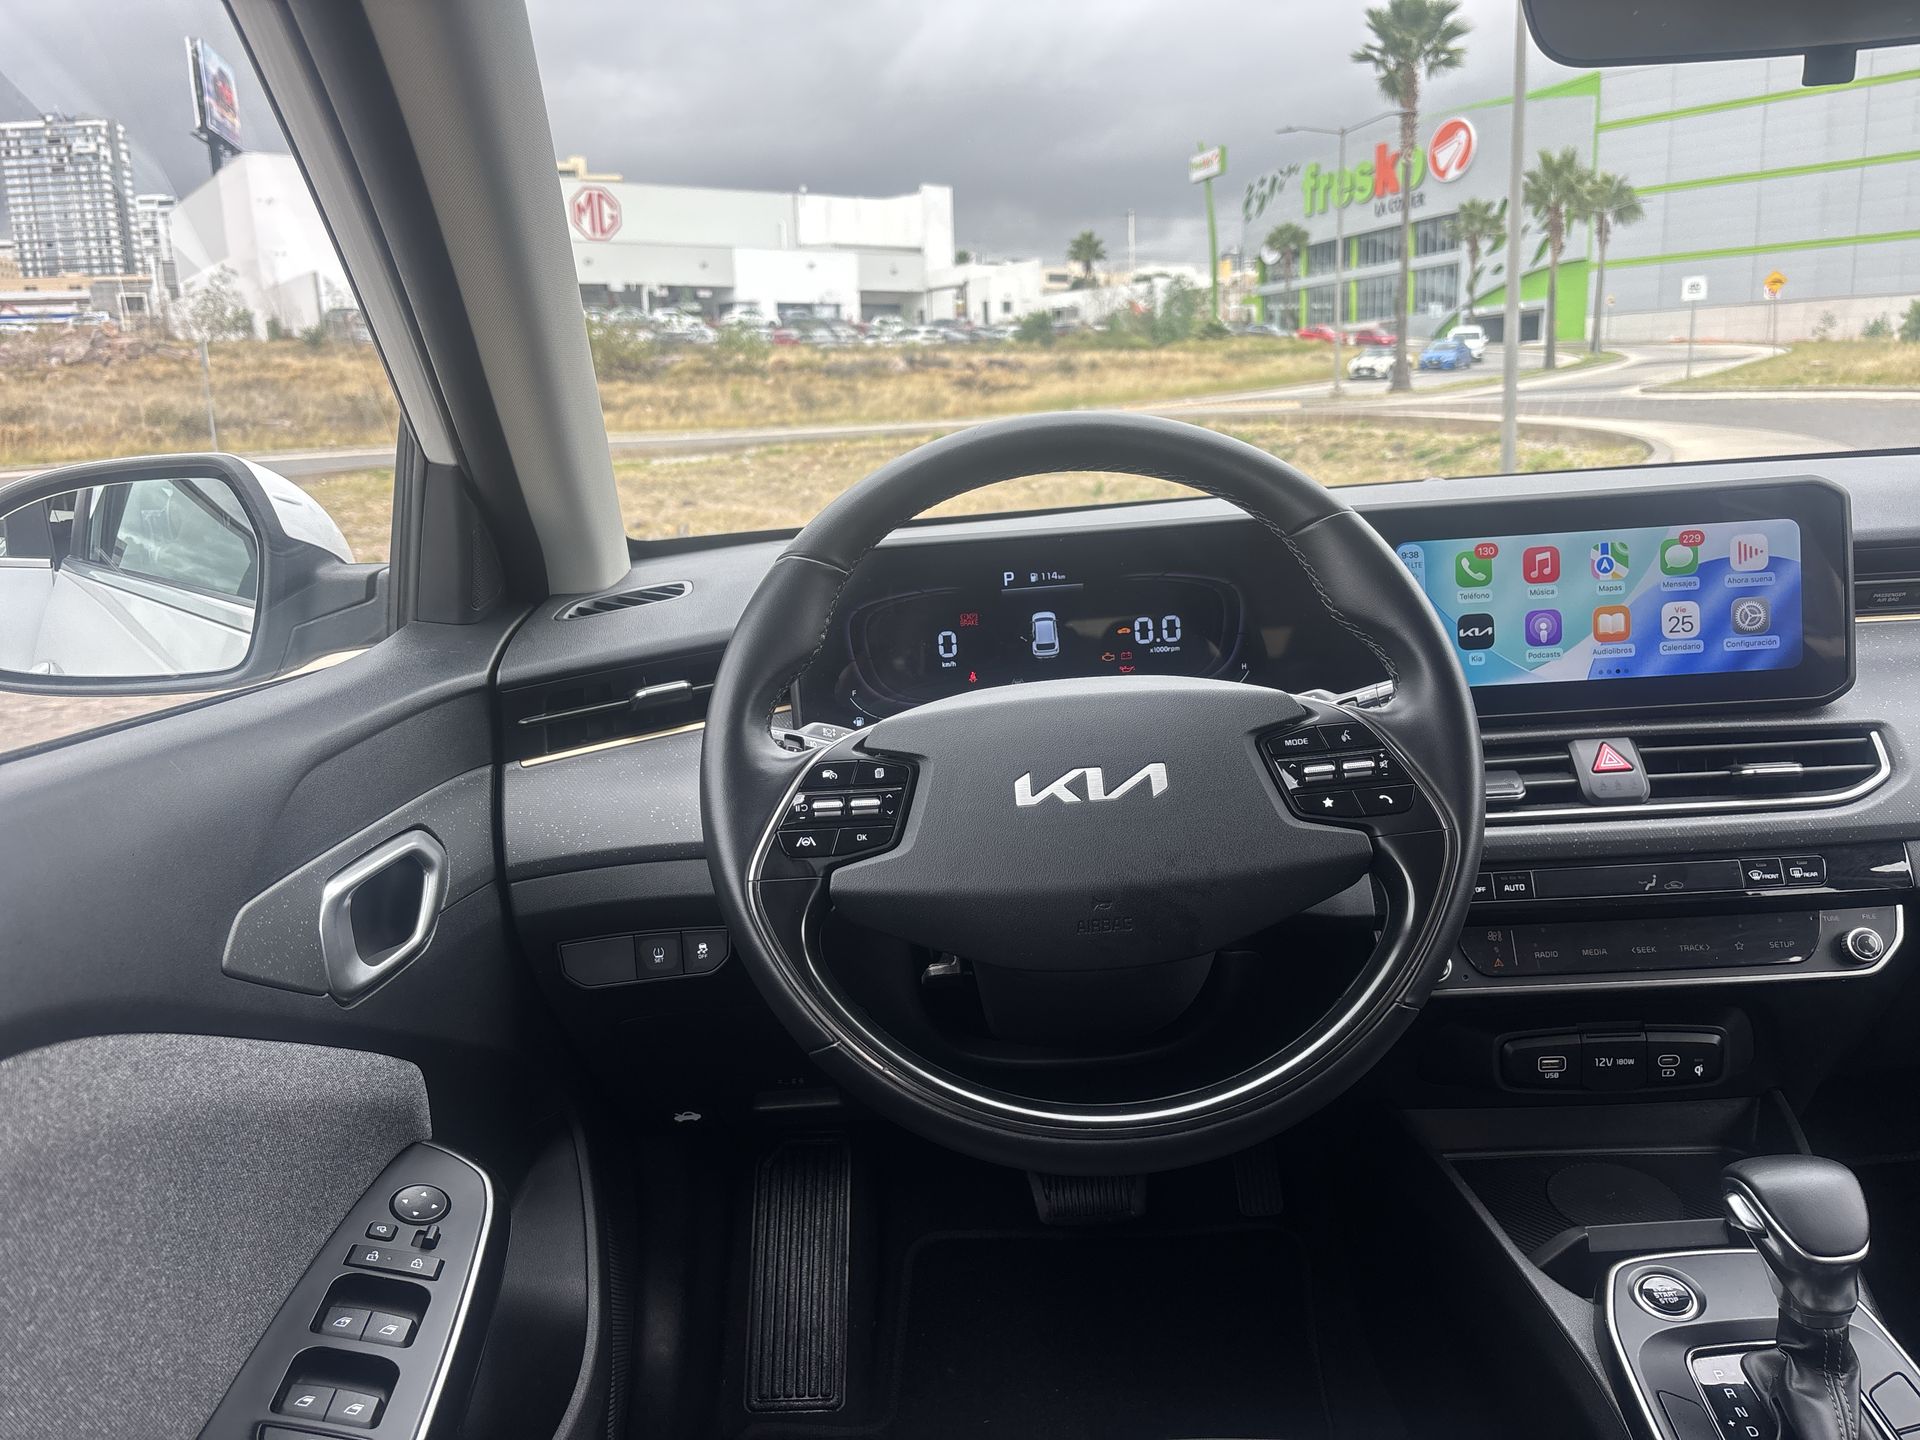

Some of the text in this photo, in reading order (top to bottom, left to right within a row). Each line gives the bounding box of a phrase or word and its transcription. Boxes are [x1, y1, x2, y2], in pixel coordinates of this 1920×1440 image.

[572, 190, 619, 236] MG
[1682, 534, 1701, 543] 229
[1401, 551, 1419, 559] 9:38
[1478, 546, 1495, 556] 130
[1411, 561, 1423, 569] LTE
[1003, 571, 1015, 587] P
[1727, 577, 1749, 585] Ahora
[1598, 584, 1623, 593] Mapas
[1662, 580, 1697, 589] Mensajes
[1460, 592, 1490, 601] Teléfono
[1529, 588, 1555, 596] Música
[1674, 606, 1687, 614] Vie
[1668, 615, 1694, 633] 25
[1134, 615, 1181, 644] 0.0
[1459, 626, 1493, 637] KIA
[938, 630, 957, 658] 0
[1661, 643, 1701, 652] Calendario
[1725, 639, 1777, 649] Configuración
[1528, 651, 1561, 659] Podcasts
[1592, 647, 1633, 655] Audiolibros
[851, 689, 857, 697] F
[1284, 737, 1309, 746] MODE
[1014, 762, 1168, 806] KIA
[856, 833, 868, 842] OK
[1761, 872, 1779, 880] FRONT
[1803, 871, 1819, 879] REAR
[1474, 885, 1486, 893] OFF
[1503, 883, 1526, 893] AUTO
[1822, 914, 1841, 922] TUNE
[1769, 940, 1795, 949] SETUP
[1534, 950, 1559, 959] RADIO
[1582, 948, 1608, 957] MEDIA
[1595, 1057, 1635, 1067] 12V 180W
[1653, 1290, 1677, 1299] START
[1658, 1296, 1679, 1304] STOP
[1713, 1370, 1724, 1380] P
[1723, 1388, 1737, 1399] R
[1734, 1406, 1749, 1418] N
[1746, 1425, 1759, 1437] D
